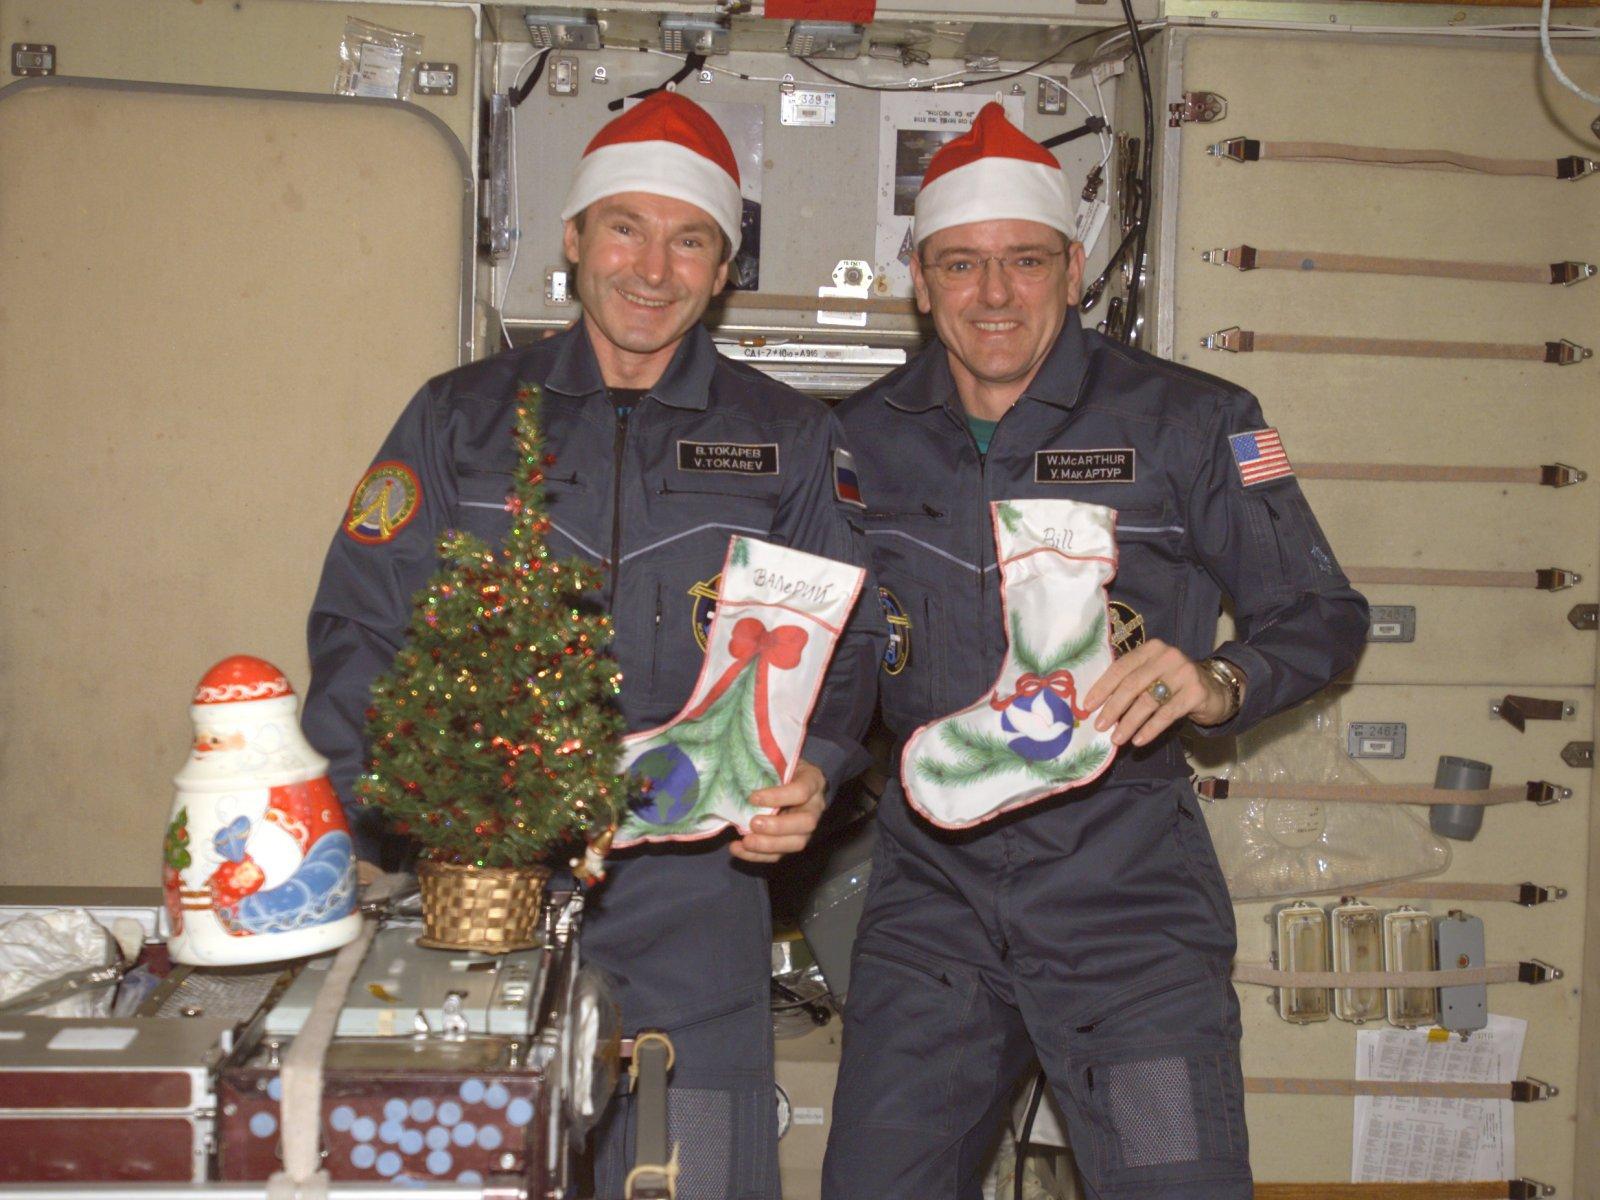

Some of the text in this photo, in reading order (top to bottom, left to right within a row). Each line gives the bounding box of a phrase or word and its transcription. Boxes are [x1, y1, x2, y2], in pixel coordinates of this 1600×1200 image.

[801, 94, 822, 105] 339
[693, 458, 763, 471] V.TOKAREV
[1042, 527, 1074, 549] Bill
